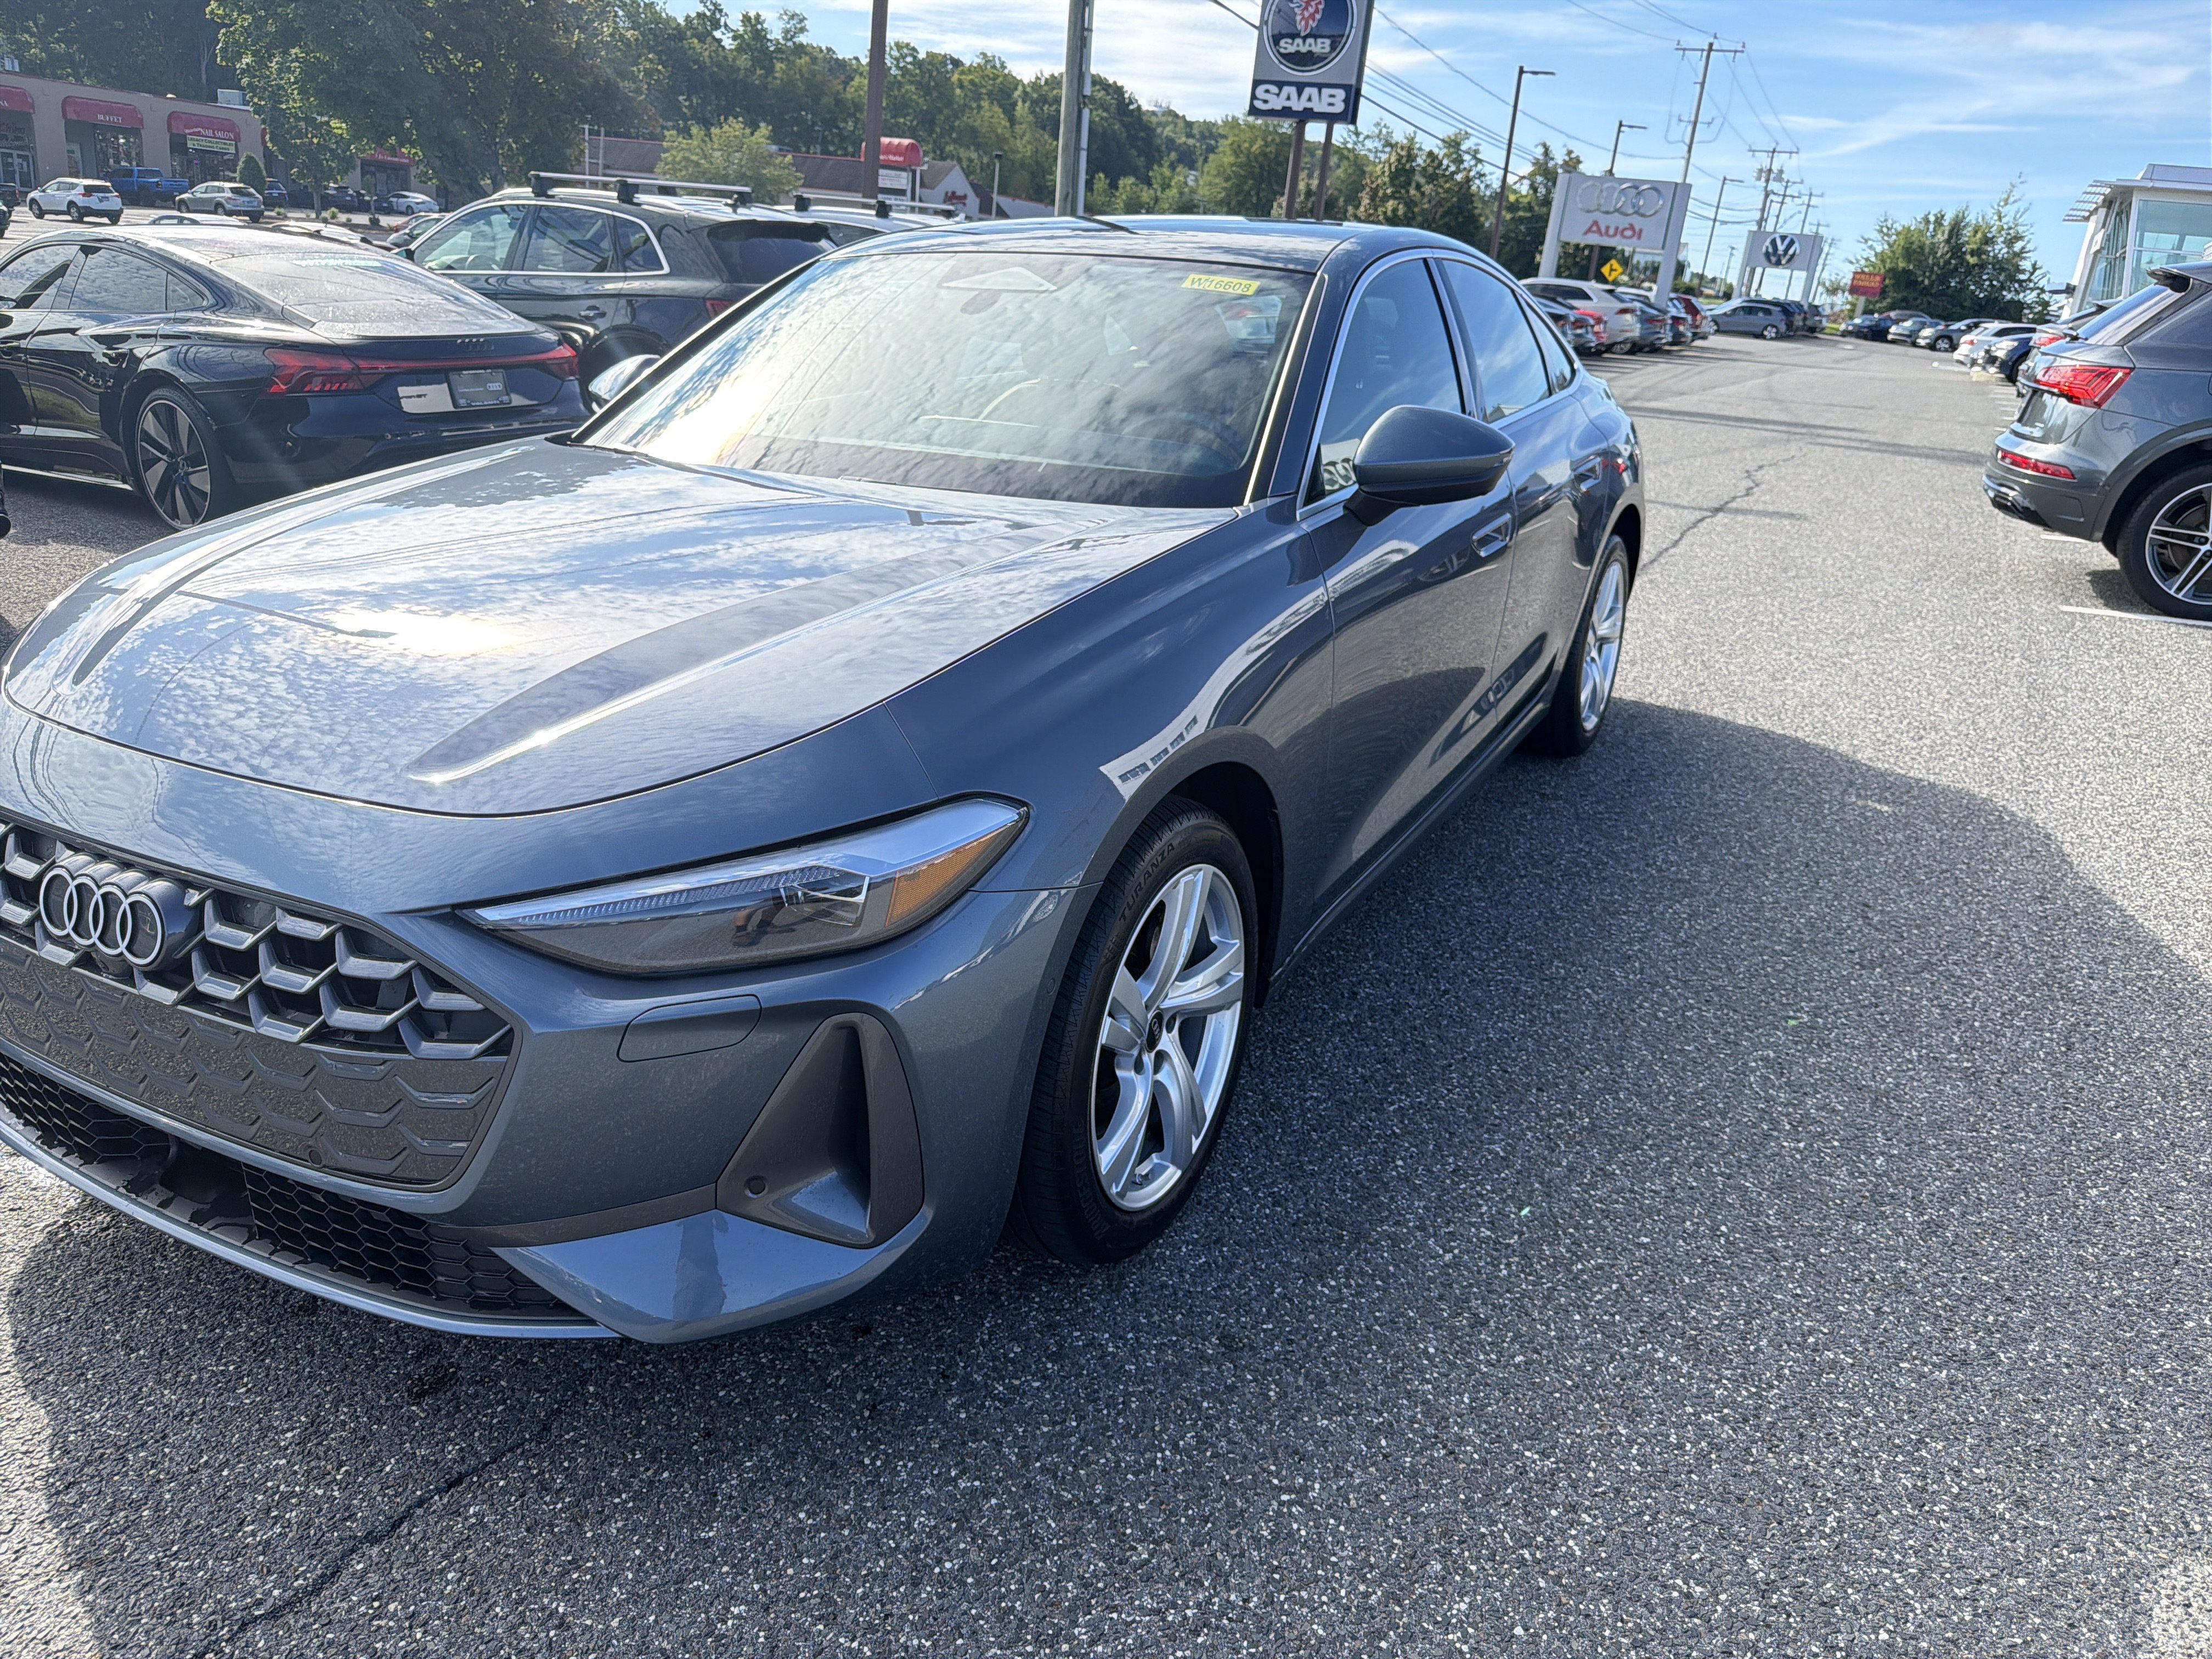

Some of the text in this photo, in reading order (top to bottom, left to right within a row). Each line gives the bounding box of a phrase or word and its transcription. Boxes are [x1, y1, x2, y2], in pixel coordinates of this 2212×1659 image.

[1278, 37, 1331, 54] SAAB
[1253, 83, 1346, 114] SAAB
[97, 114, 122, 123] BUFFET
[200, 128, 214, 137] NAIL
[215, 130, 234, 139] SALON
[1582, 219, 1643, 241] Audi
[1119, 842, 1175, 922] TURANZA
